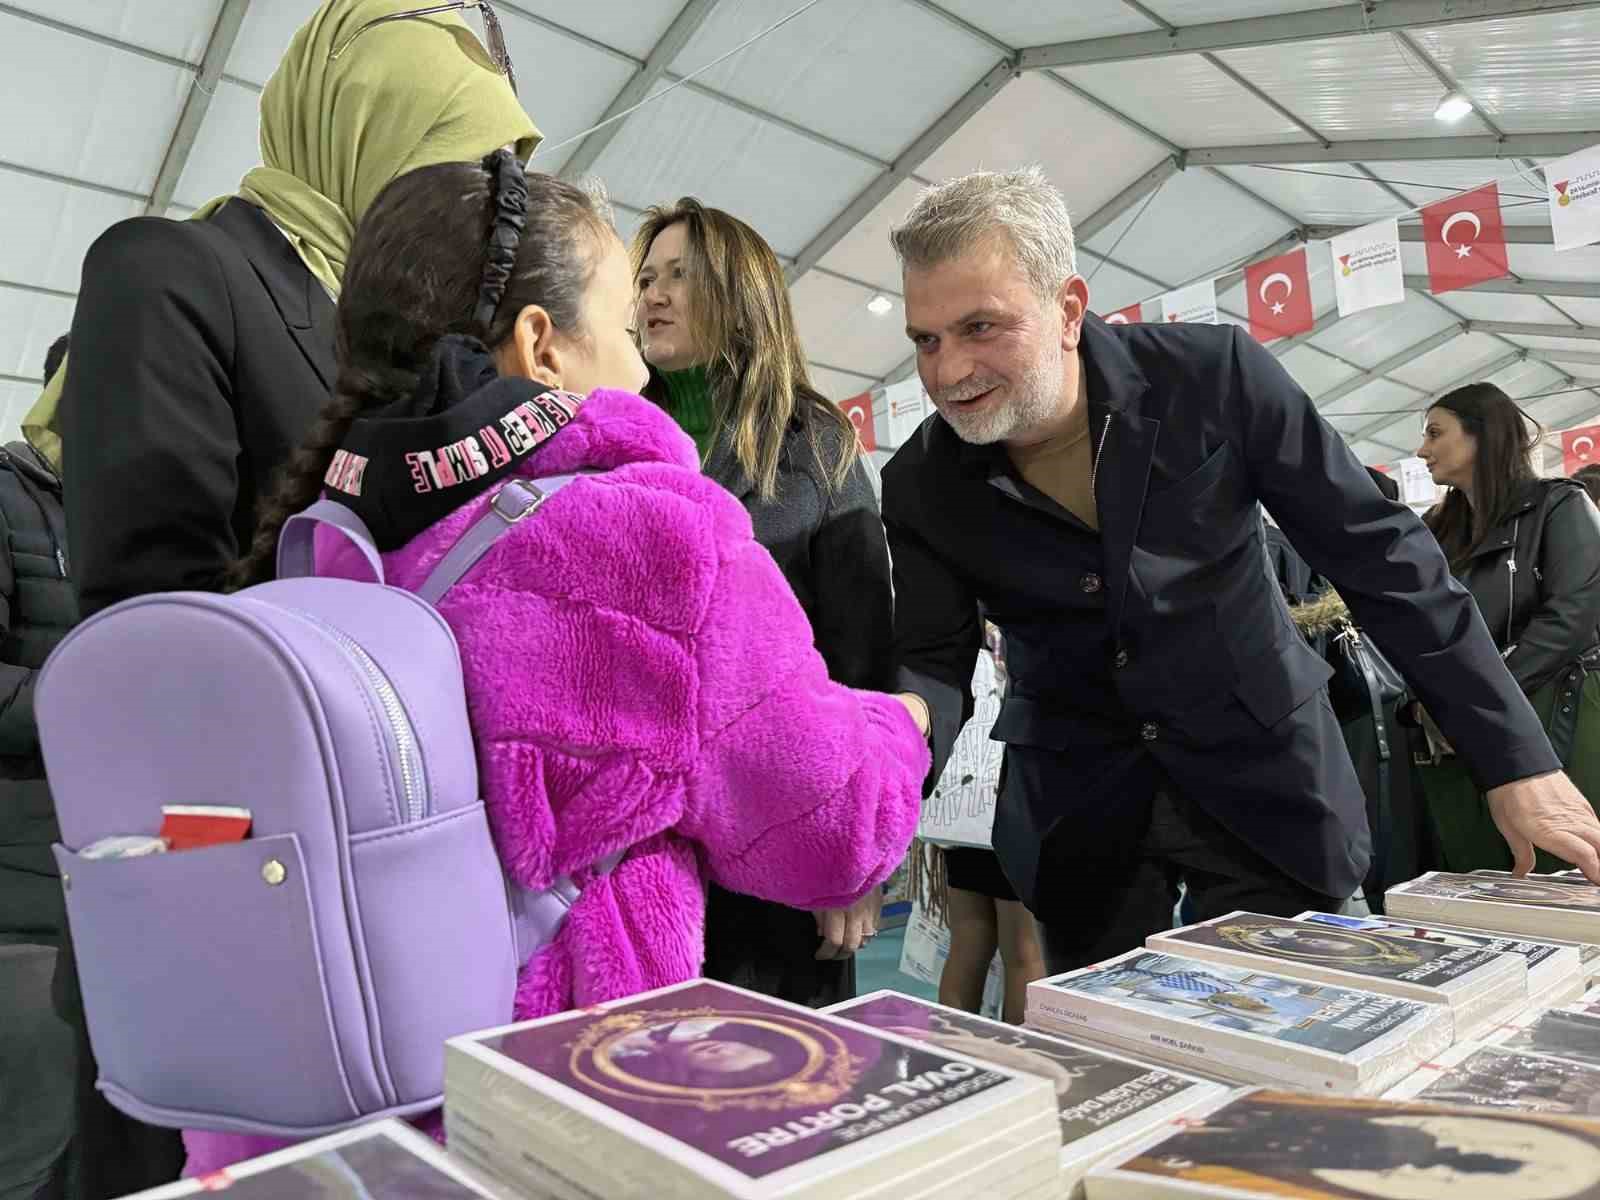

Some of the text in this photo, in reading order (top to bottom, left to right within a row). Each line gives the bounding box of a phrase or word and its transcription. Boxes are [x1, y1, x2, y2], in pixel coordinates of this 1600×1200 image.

[479, 424, 512, 469] IT
[499, 400, 557, 456] KEEP
[405, 435, 489, 494] SIMPLE
[727, 1061, 976, 1158] OVAL PORTRE
